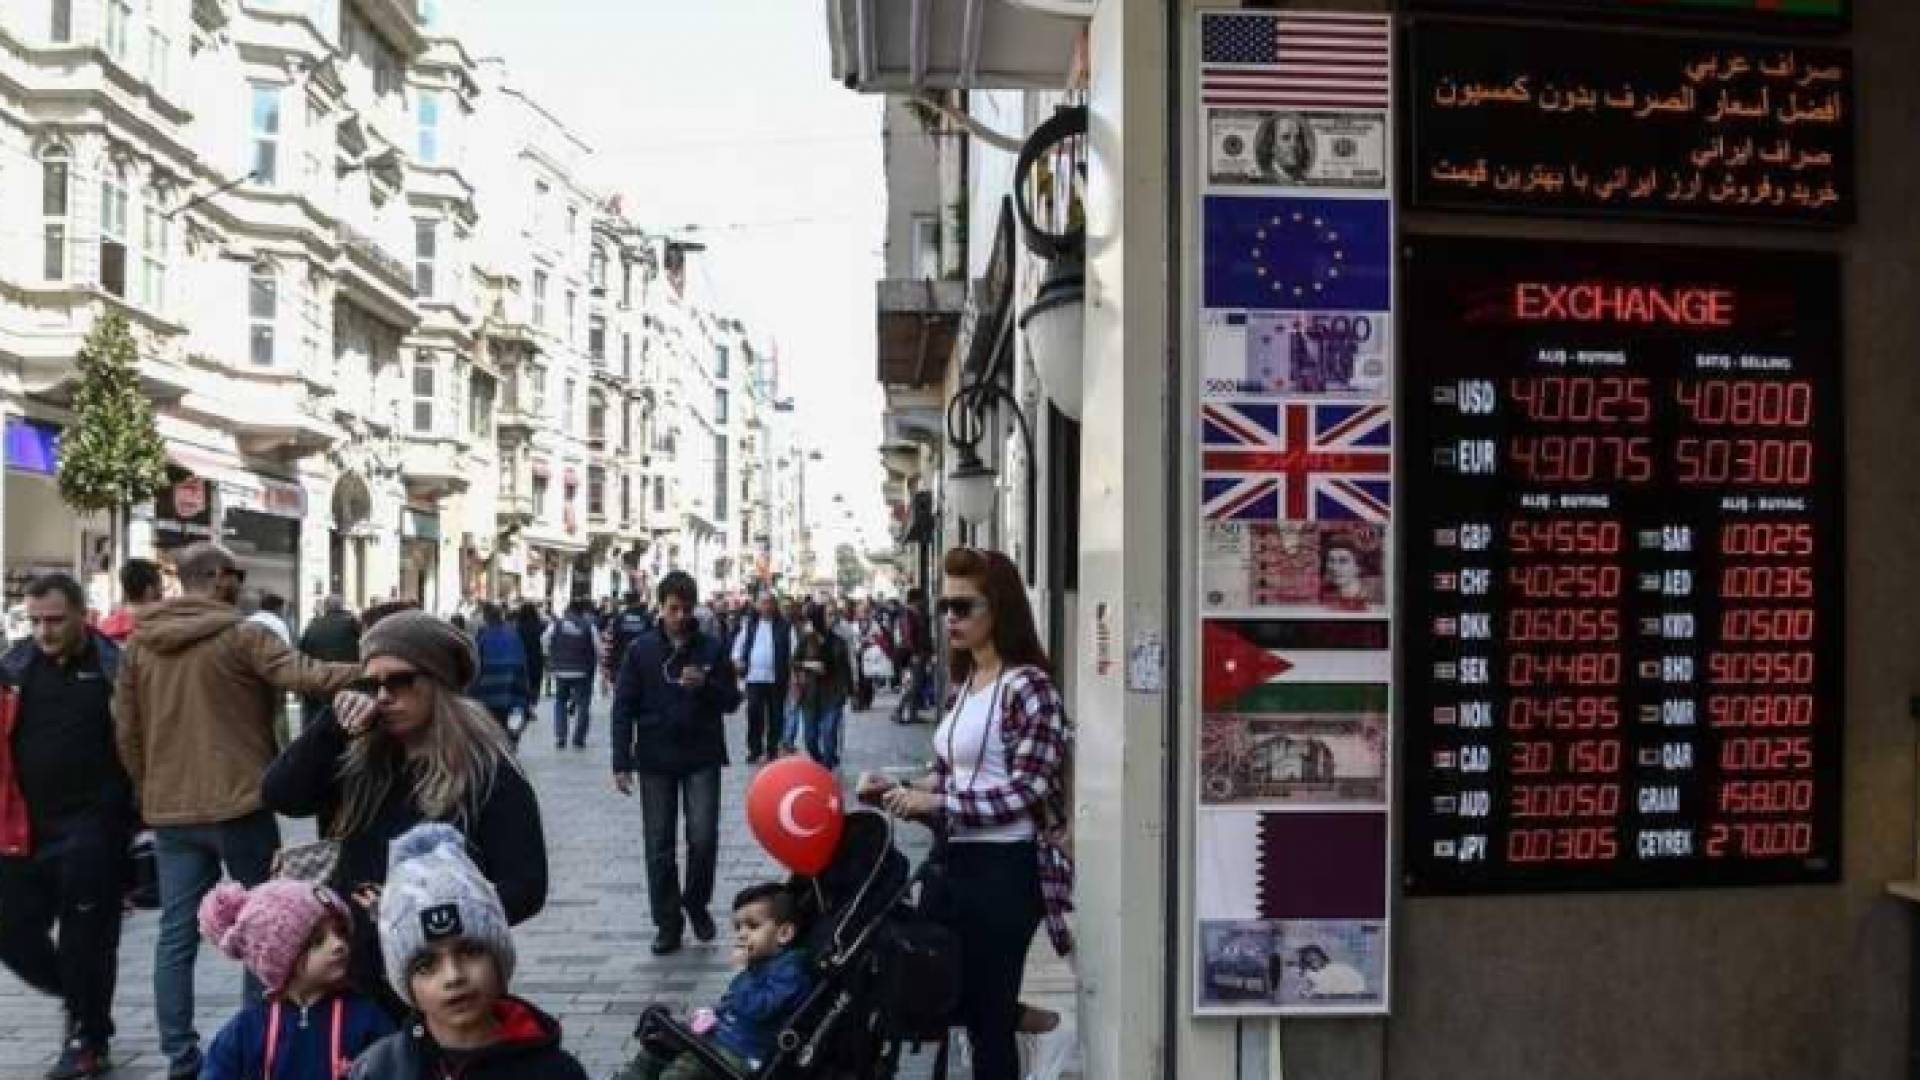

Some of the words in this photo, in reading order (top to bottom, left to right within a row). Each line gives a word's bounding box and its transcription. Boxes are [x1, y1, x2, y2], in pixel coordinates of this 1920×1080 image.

[1516, 281, 1736, 327] EXCHANGE
[1457, 379, 1496, 415] USD
[1458, 438, 1497, 474] EUR
[1460, 568, 1491, 595] CHF
[1460, 656, 1490, 684] SEK
[1662, 655, 1694, 682] BHD
[1460, 744, 1490, 773] CAD
[1458, 833, 1489, 862] JPY
